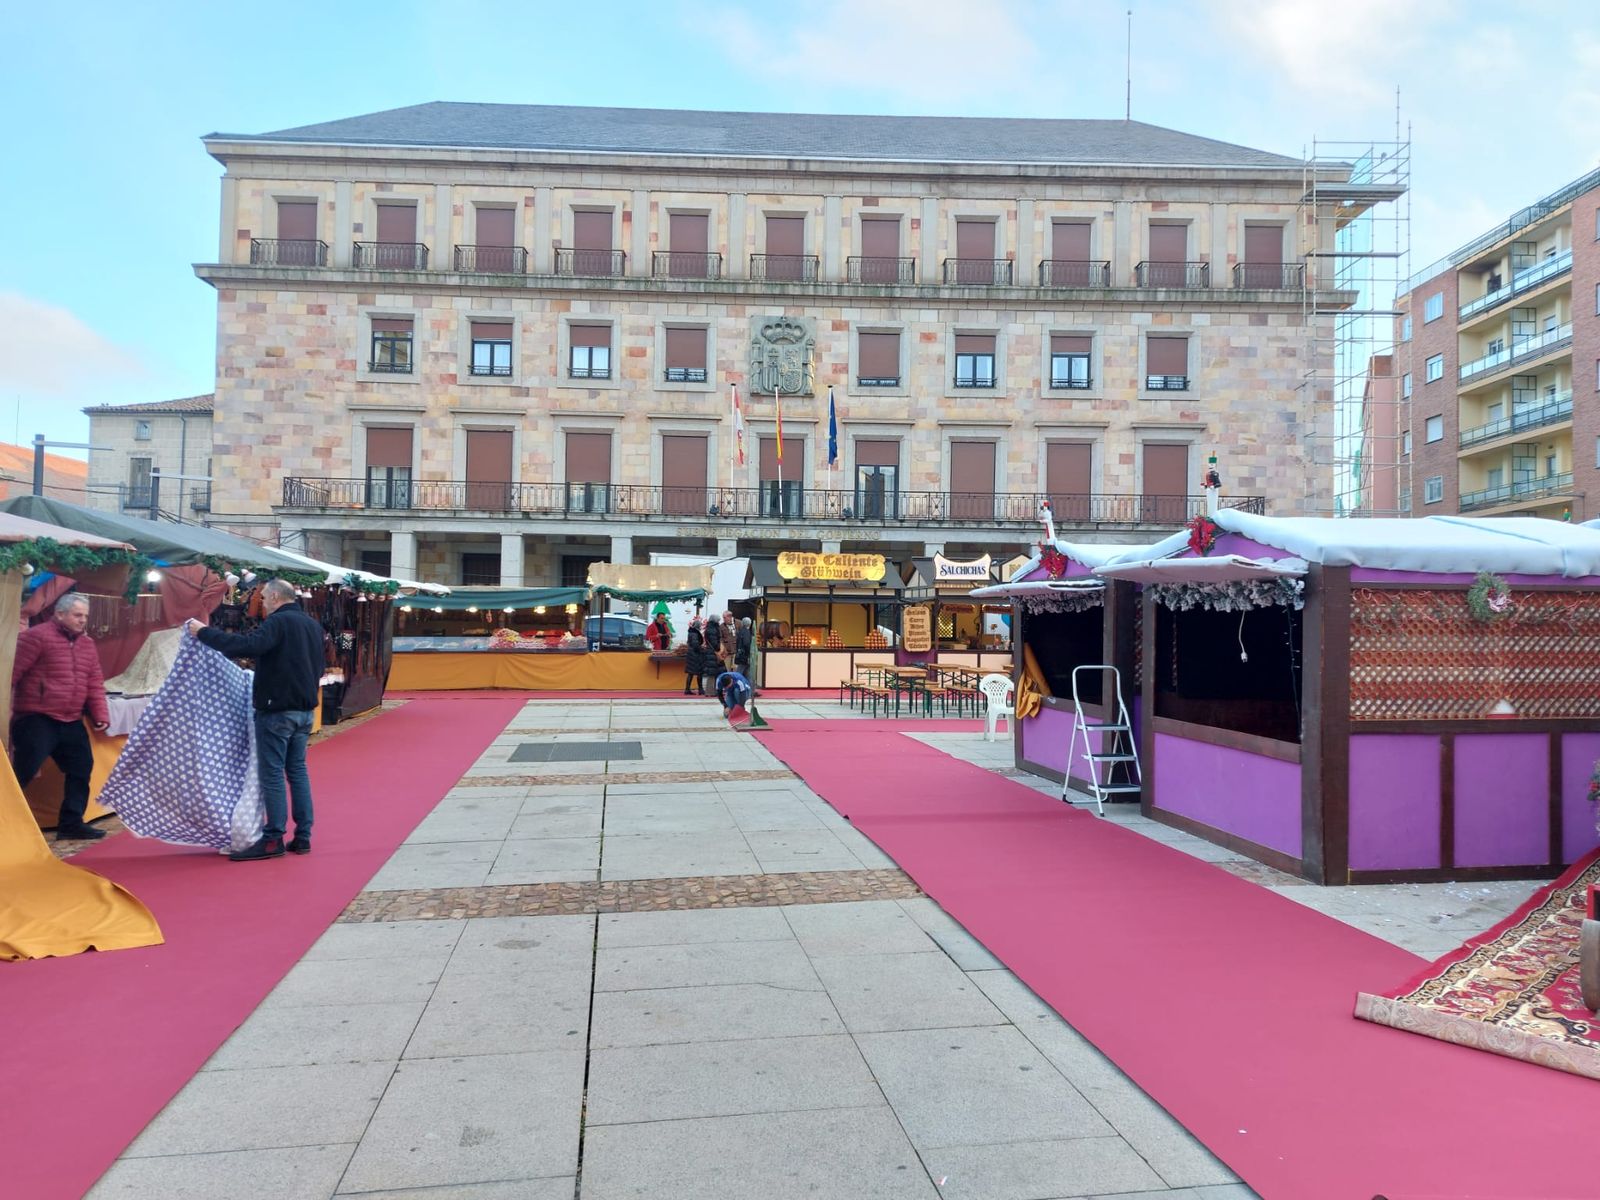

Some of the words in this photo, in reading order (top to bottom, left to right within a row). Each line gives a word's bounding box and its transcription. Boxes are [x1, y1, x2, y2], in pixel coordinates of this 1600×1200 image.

[785, 552, 817, 565] Vino
[823, 555, 878, 567] Caliente
[801, 566, 862, 578] Glühwein
[940, 565, 986, 576] SALCHICHAS
